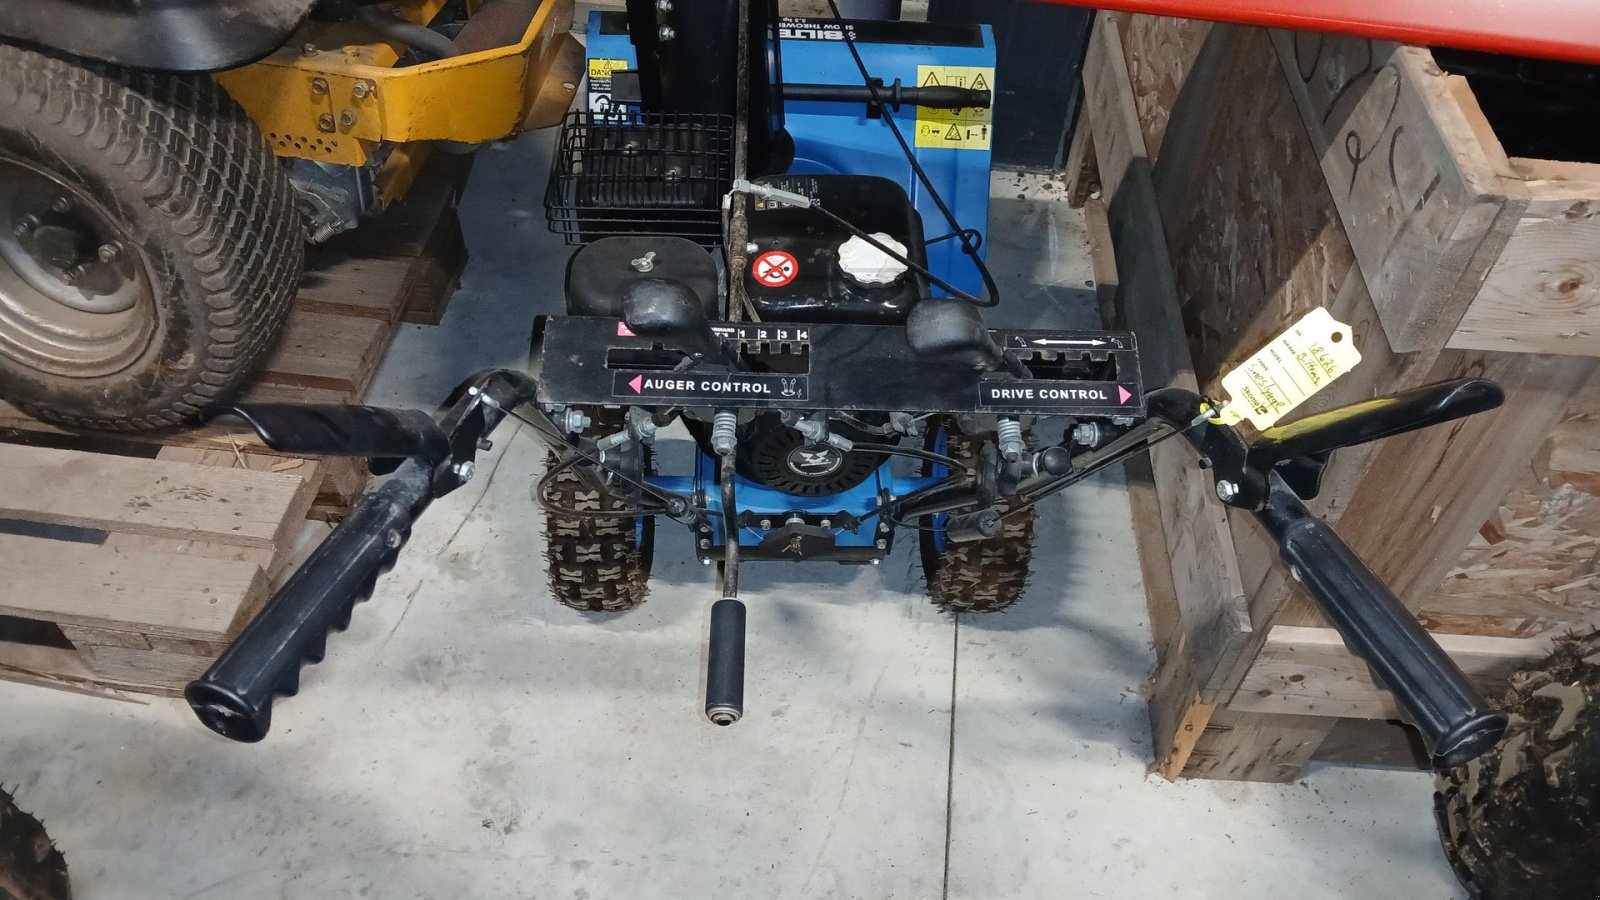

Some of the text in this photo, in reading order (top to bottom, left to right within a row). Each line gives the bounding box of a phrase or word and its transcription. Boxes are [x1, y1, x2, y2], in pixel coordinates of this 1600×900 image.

[779, 28, 844, 40] BILTE
[591, 69, 612, 77] DANG
[740, 330, 808, 339] 1 2 3 4
[644, 379, 771, 394] AUGER CONTROL
[991, 388, 1108, 400] DRIVE CONTROL
